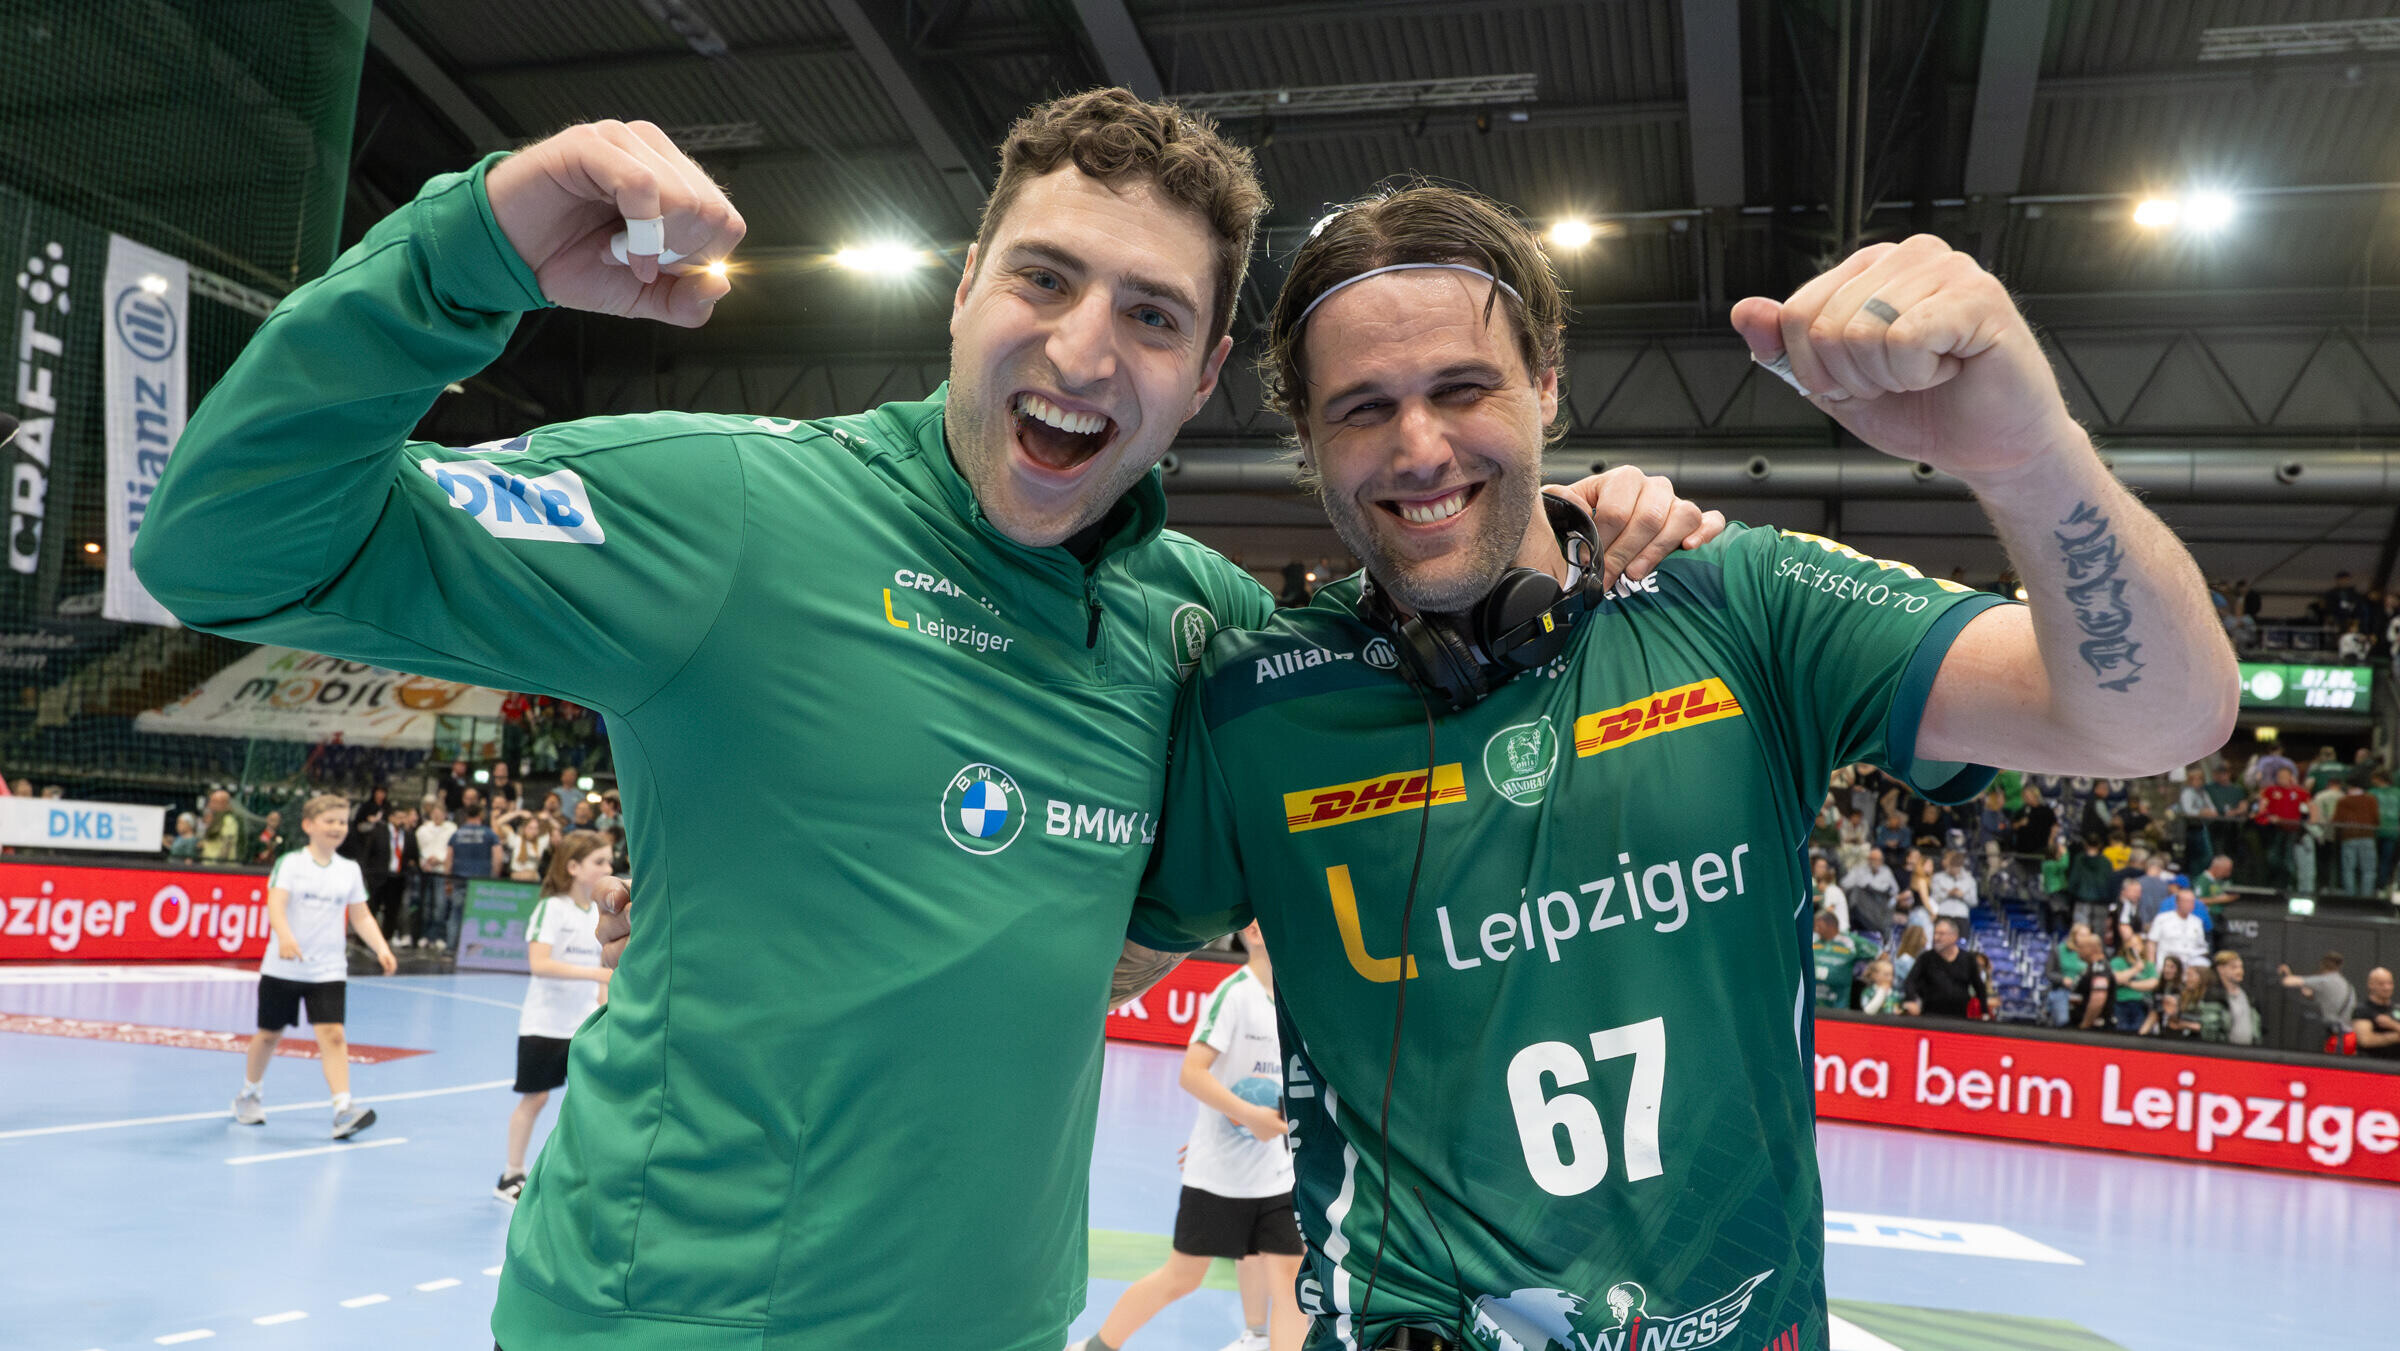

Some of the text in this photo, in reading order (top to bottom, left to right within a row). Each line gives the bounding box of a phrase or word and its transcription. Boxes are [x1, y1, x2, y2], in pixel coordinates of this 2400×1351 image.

[9, 309, 64, 574] CRAFT
[127, 376, 169, 571] ianz
[435, 469, 585, 527] DKB
[916, 612, 1014, 653] Leipziger
[1598, 687, 1719, 745] DHL
[48, 808, 114, 840] DKB
[1046, 799, 1138, 844] BMW
[1310, 775, 1440, 822] DHL
[0, 880, 137, 952] ziger
[1435, 843, 1749, 970] Leipziger
[2228, 920, 2259, 938] WC
[1507, 1016, 1666, 1197] 67
[1916, 1037, 2073, 1119] beim
[2101, 1063, 2400, 1167] Leipzige
